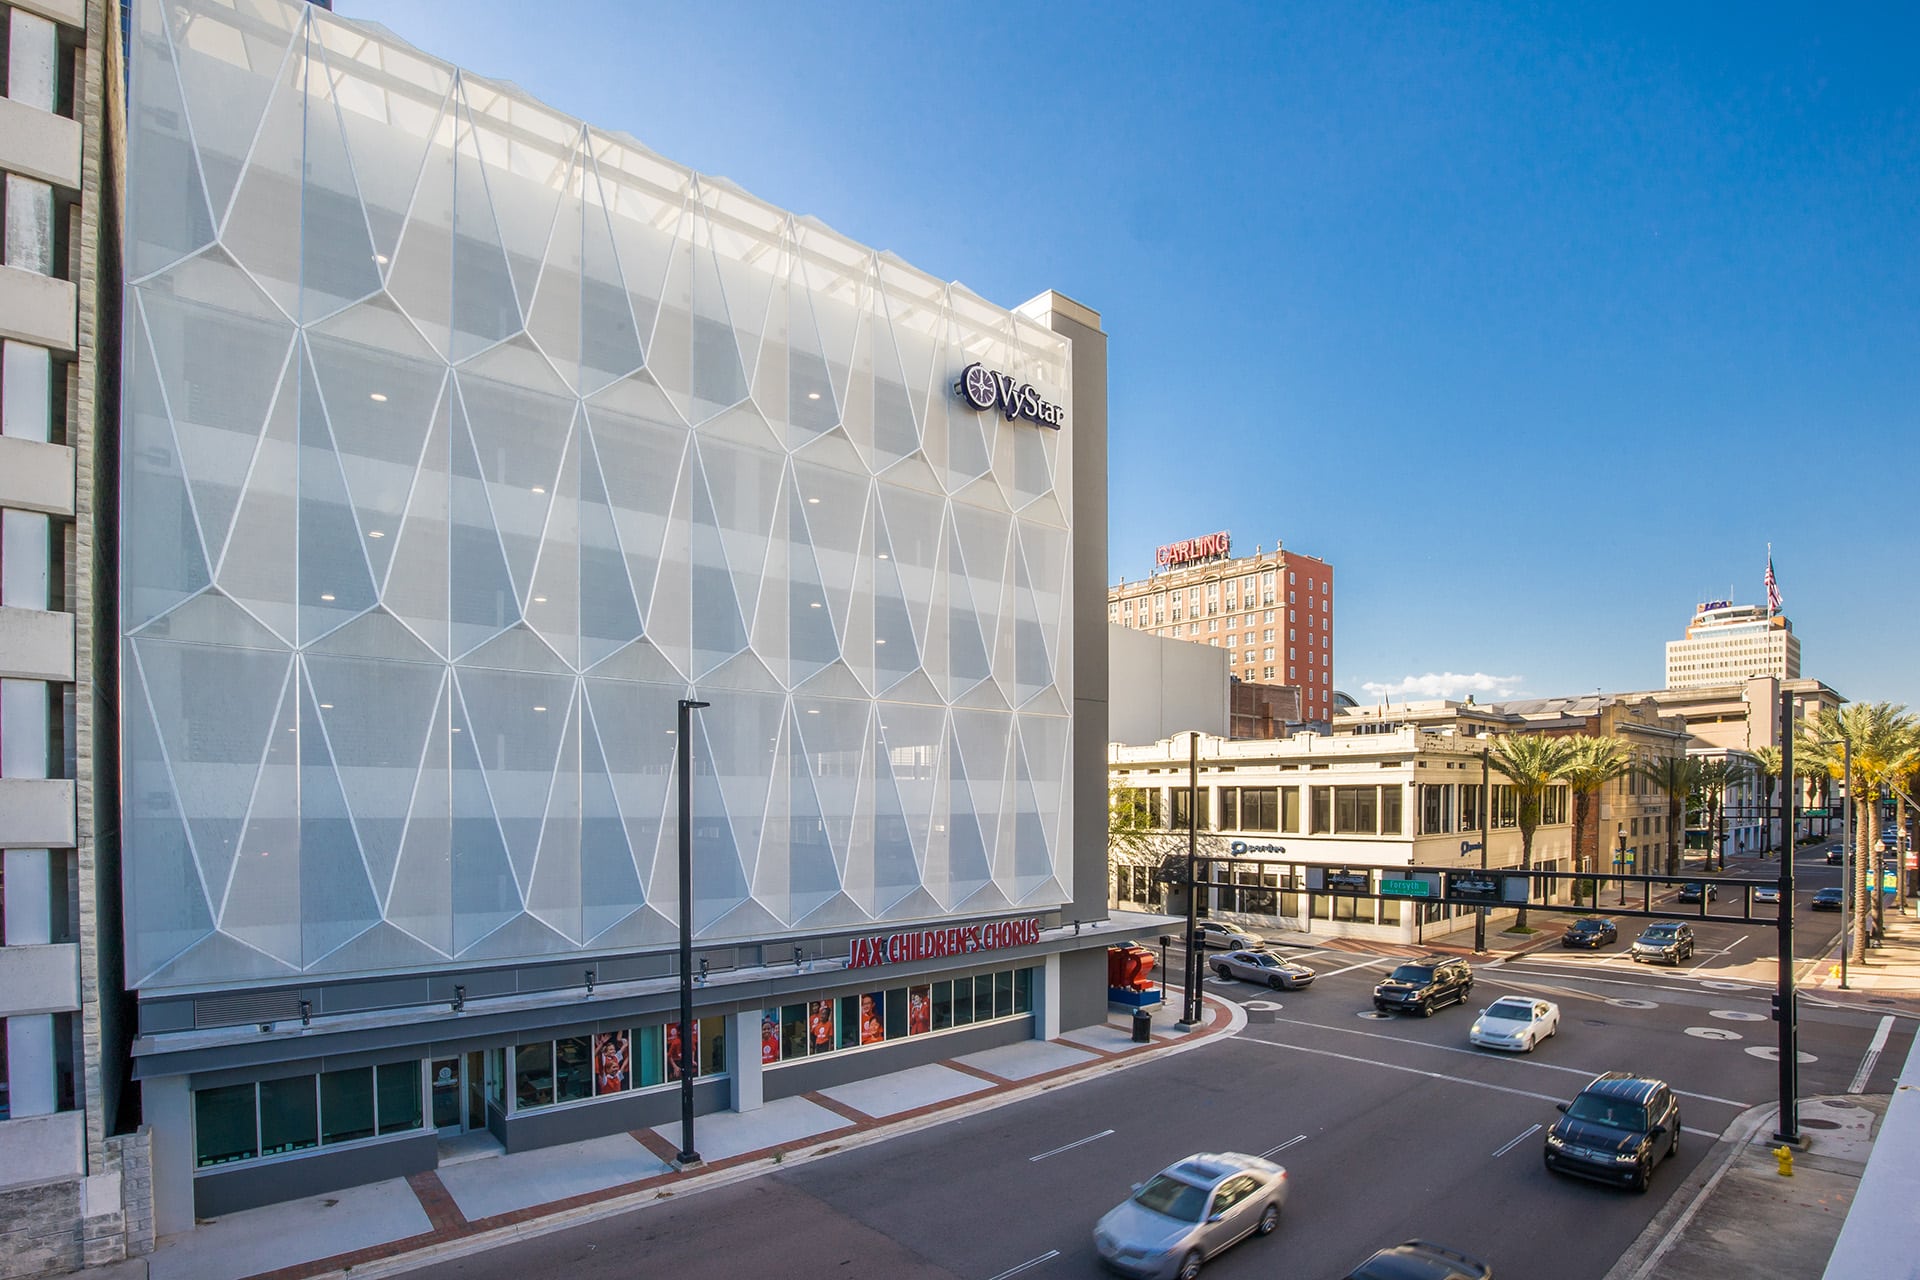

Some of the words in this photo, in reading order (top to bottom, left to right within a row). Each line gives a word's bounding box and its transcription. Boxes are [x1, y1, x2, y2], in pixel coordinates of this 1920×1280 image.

[991, 370, 1064, 428] VyStar
[1156, 531, 1230, 567] CARLING
[1390, 880, 1419, 890] Forsyth
[848, 936, 882, 969] JAX
[887, 926, 980, 963] CHILDREN'S
[982, 918, 1040, 951] CHORUS
